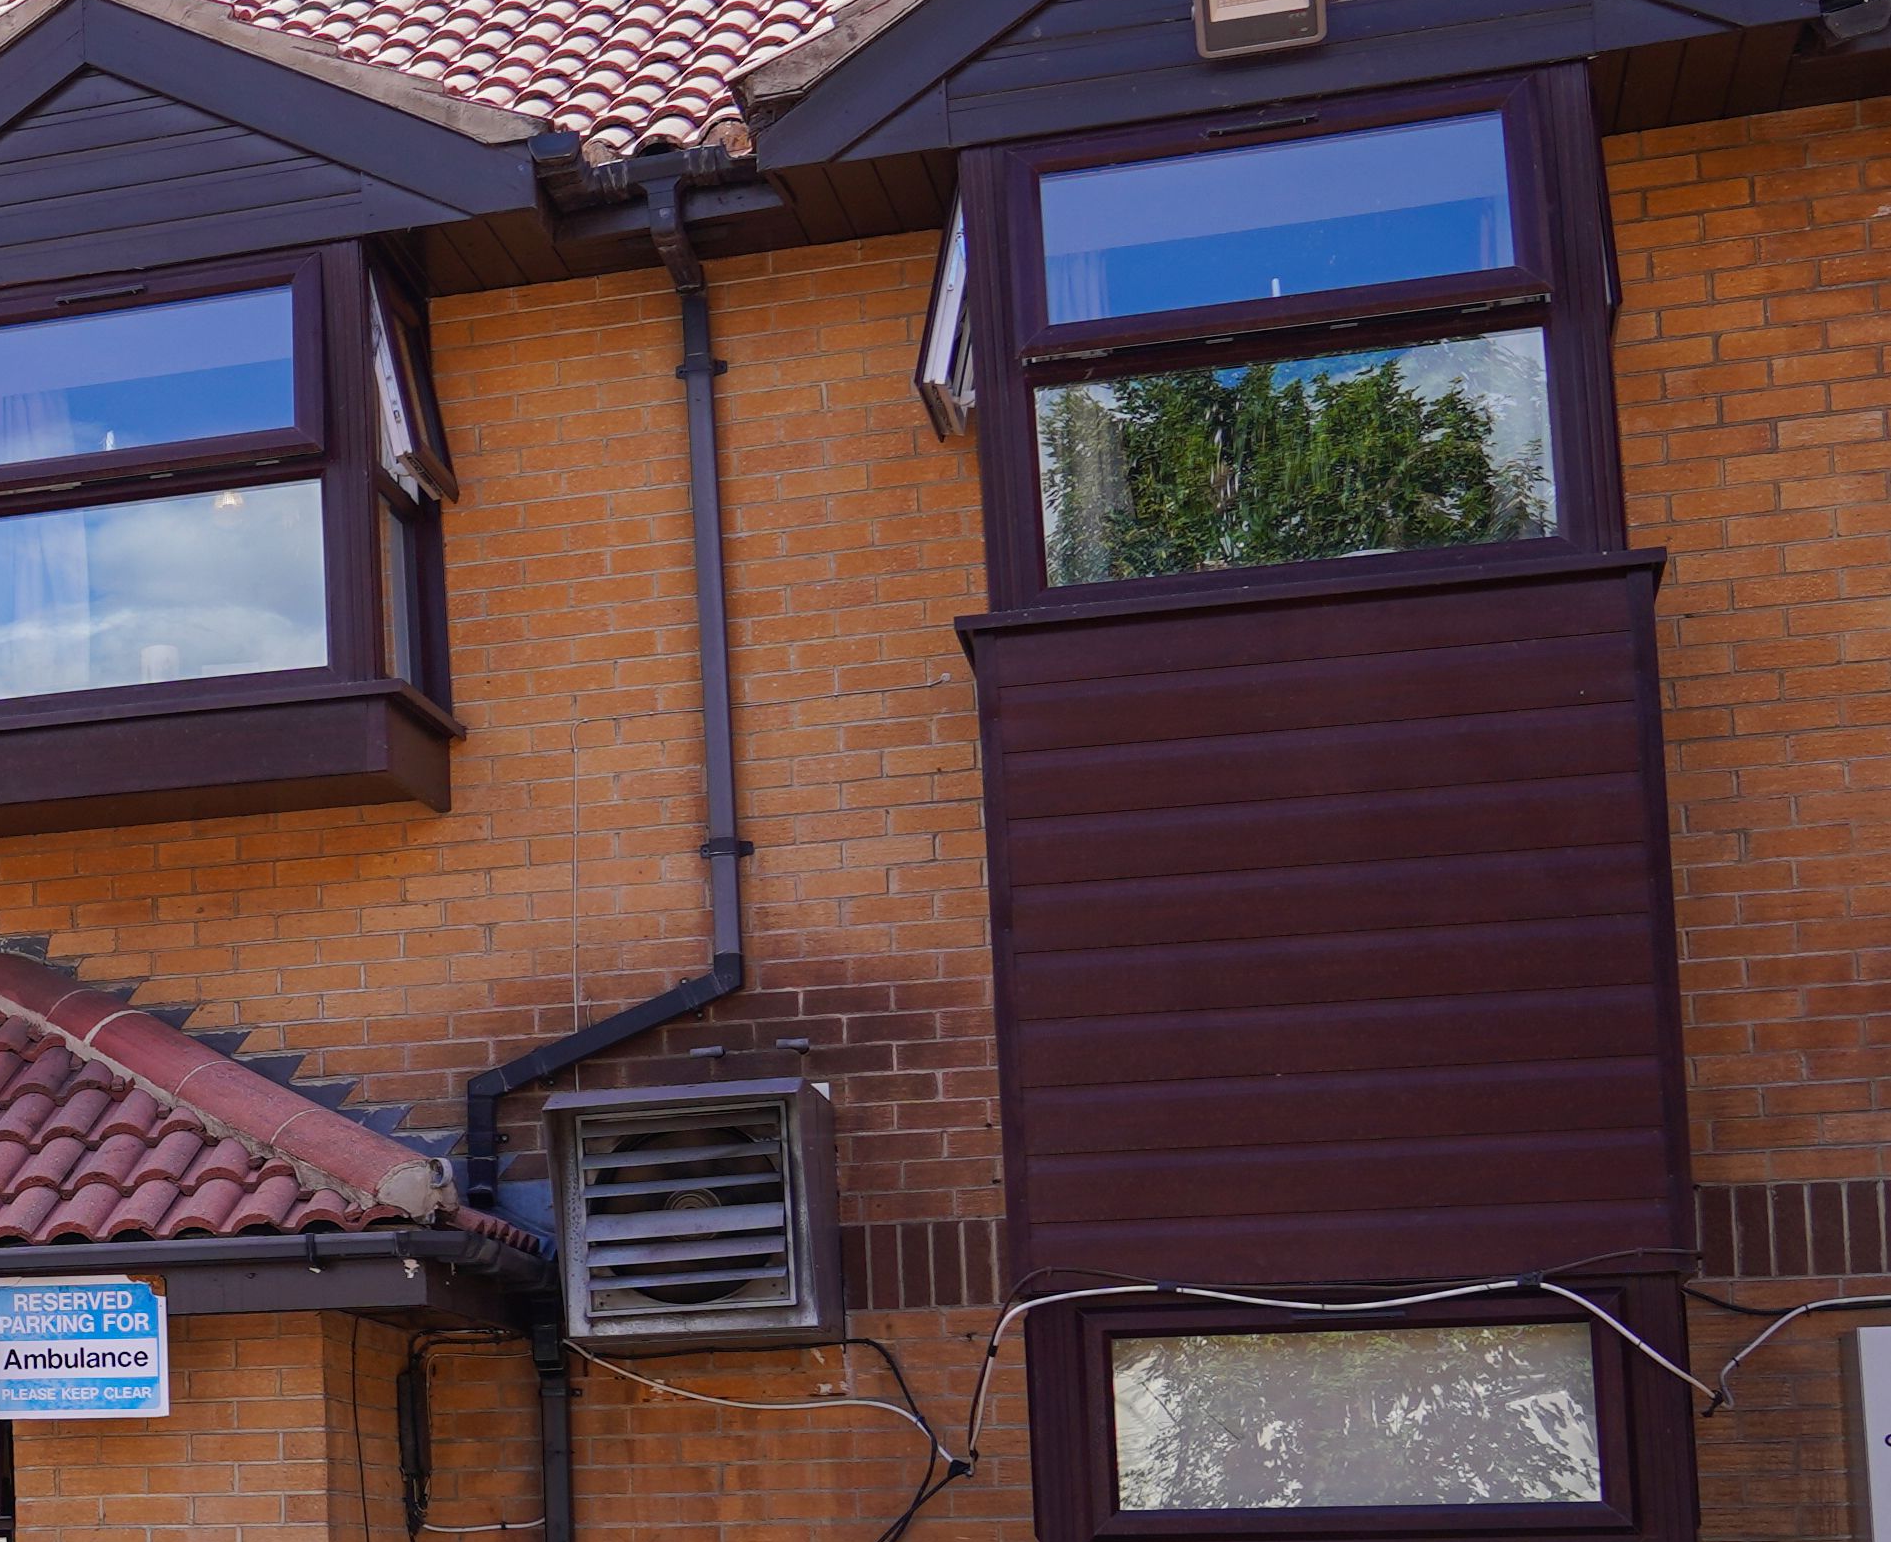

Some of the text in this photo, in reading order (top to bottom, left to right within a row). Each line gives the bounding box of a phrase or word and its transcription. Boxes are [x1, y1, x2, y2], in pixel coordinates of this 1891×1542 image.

[13, 1290, 133, 1312] RESERVED
[103, 1312, 150, 1332] FOR
[3, 1347, 149, 1371] Ambulance
[1, 1386, 153, 1401] PLEASE KEEP CLEAR
